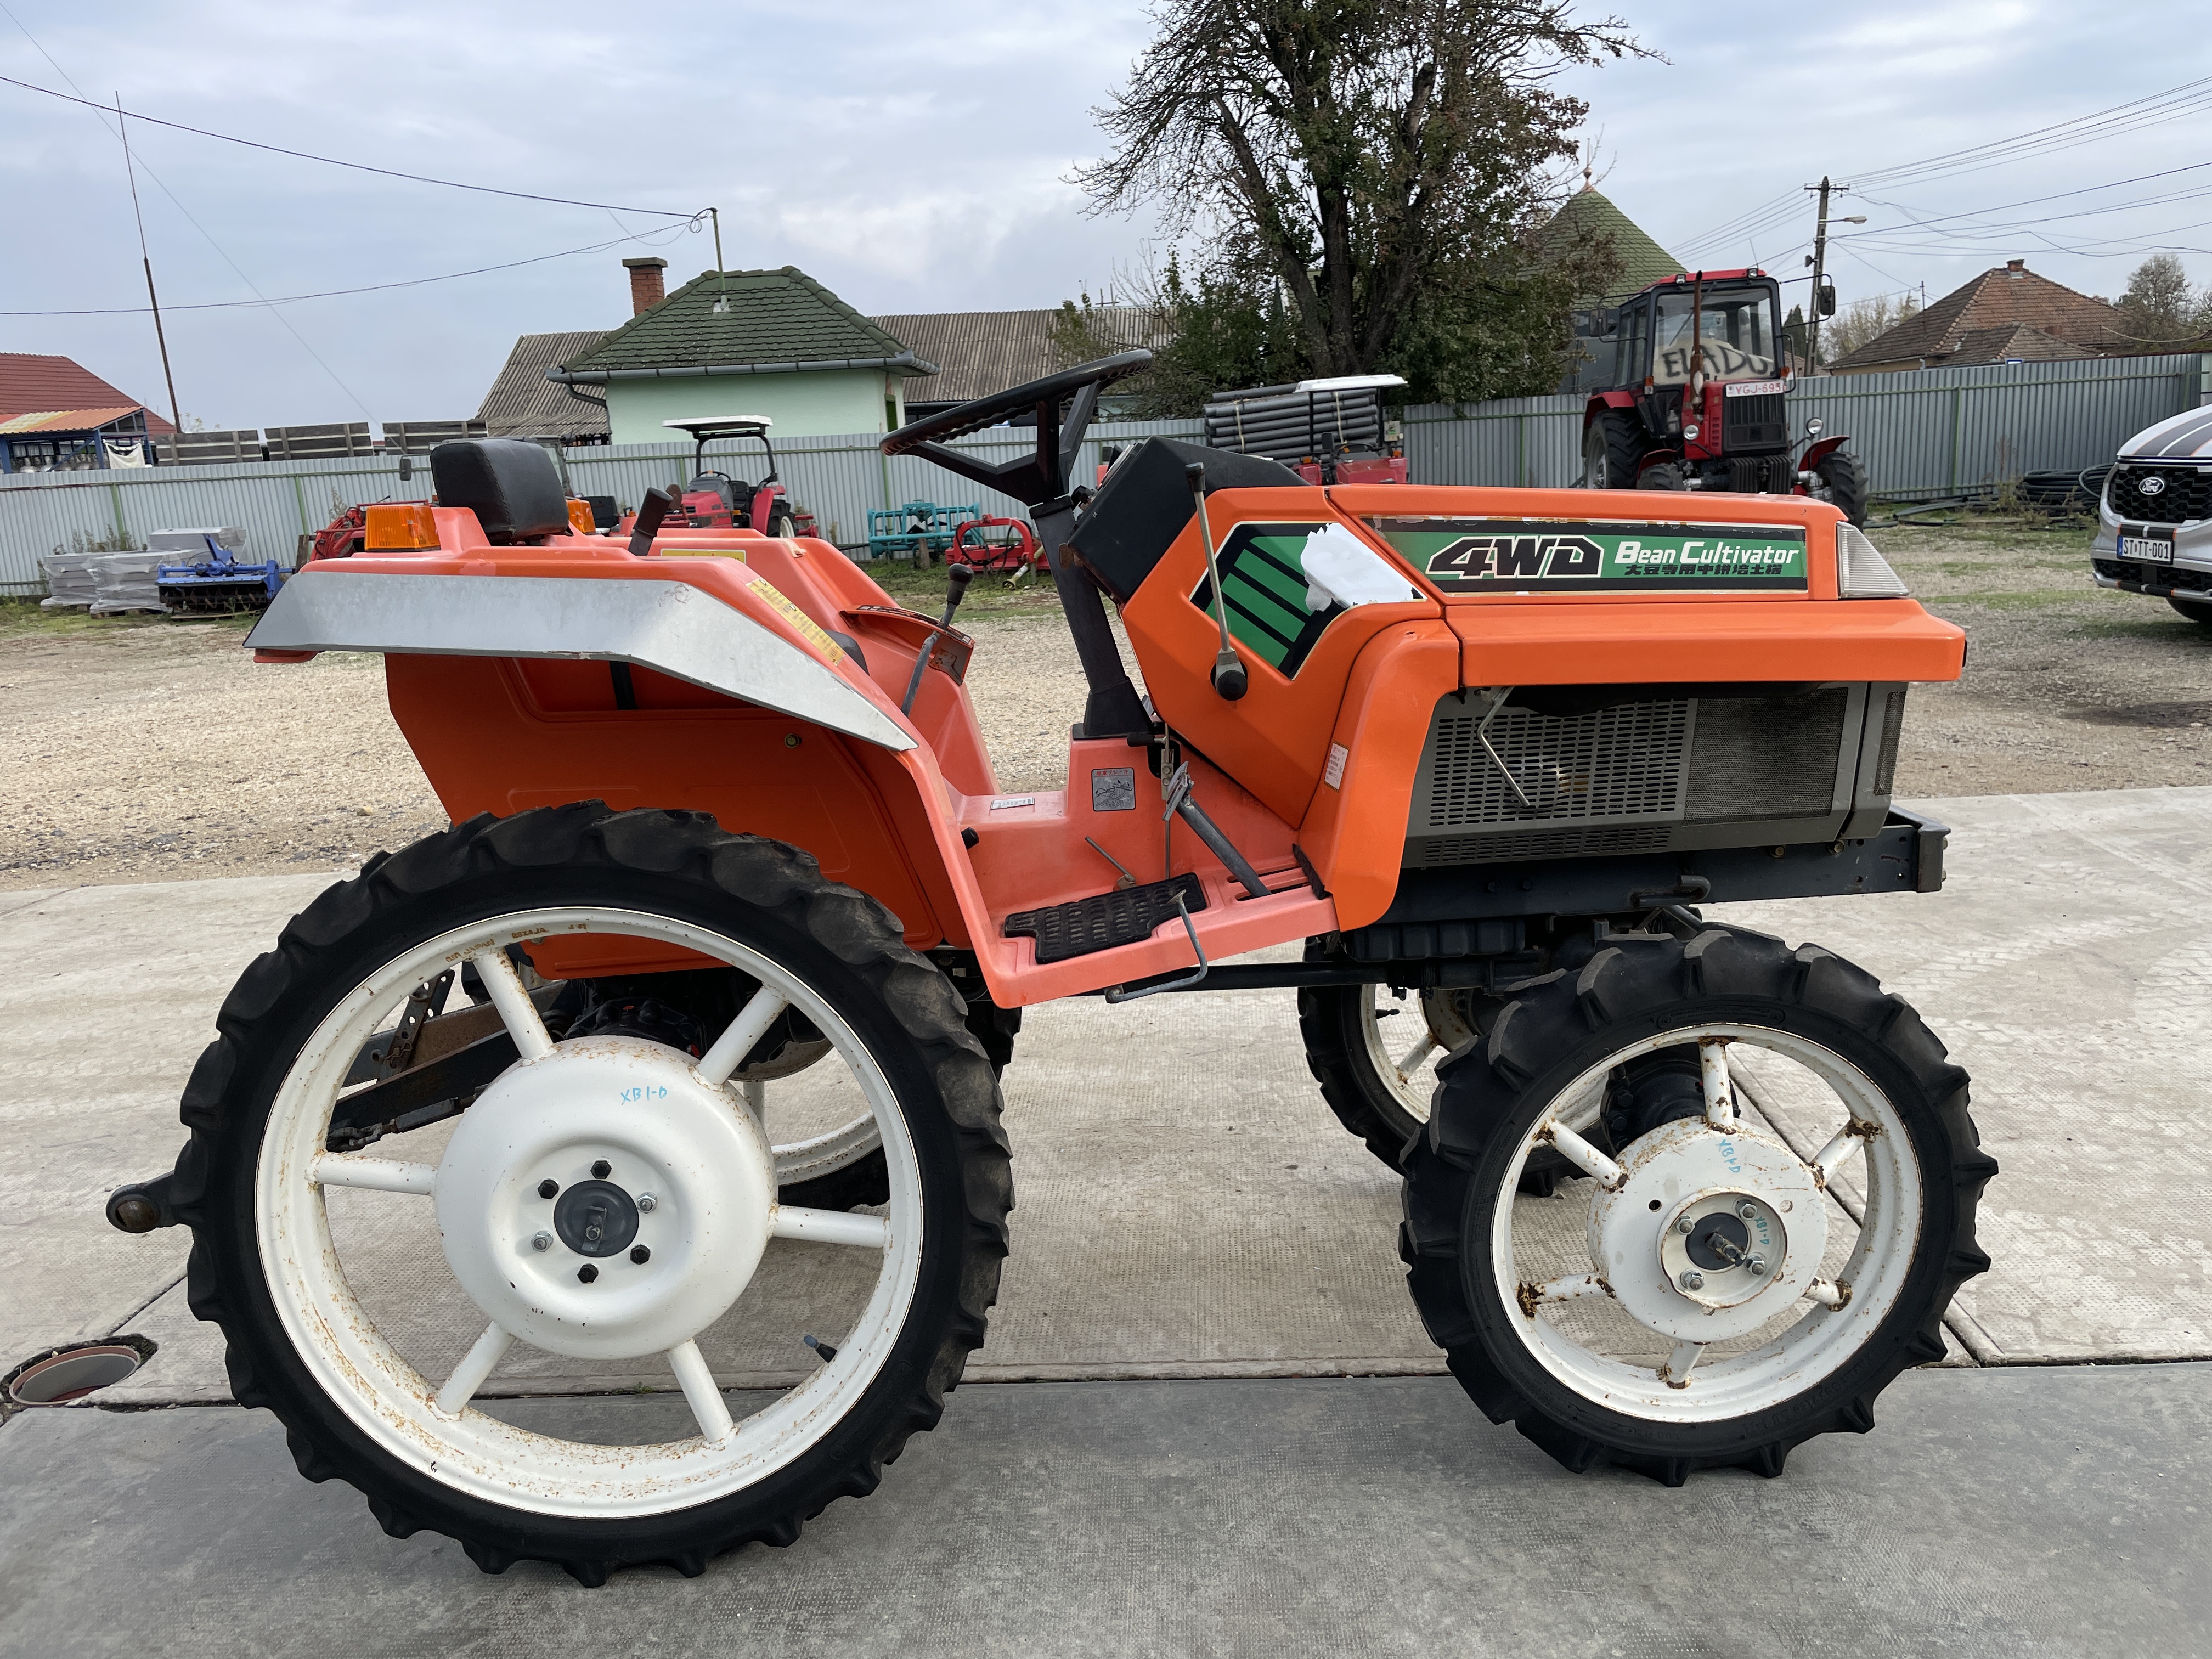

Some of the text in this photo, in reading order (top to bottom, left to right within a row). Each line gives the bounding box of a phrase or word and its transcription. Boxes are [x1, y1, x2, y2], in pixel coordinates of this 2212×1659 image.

[1736, 382, 1781, 395] YGJ-695
[1426, 535, 1799, 579] 4WD Bean Cultivator
